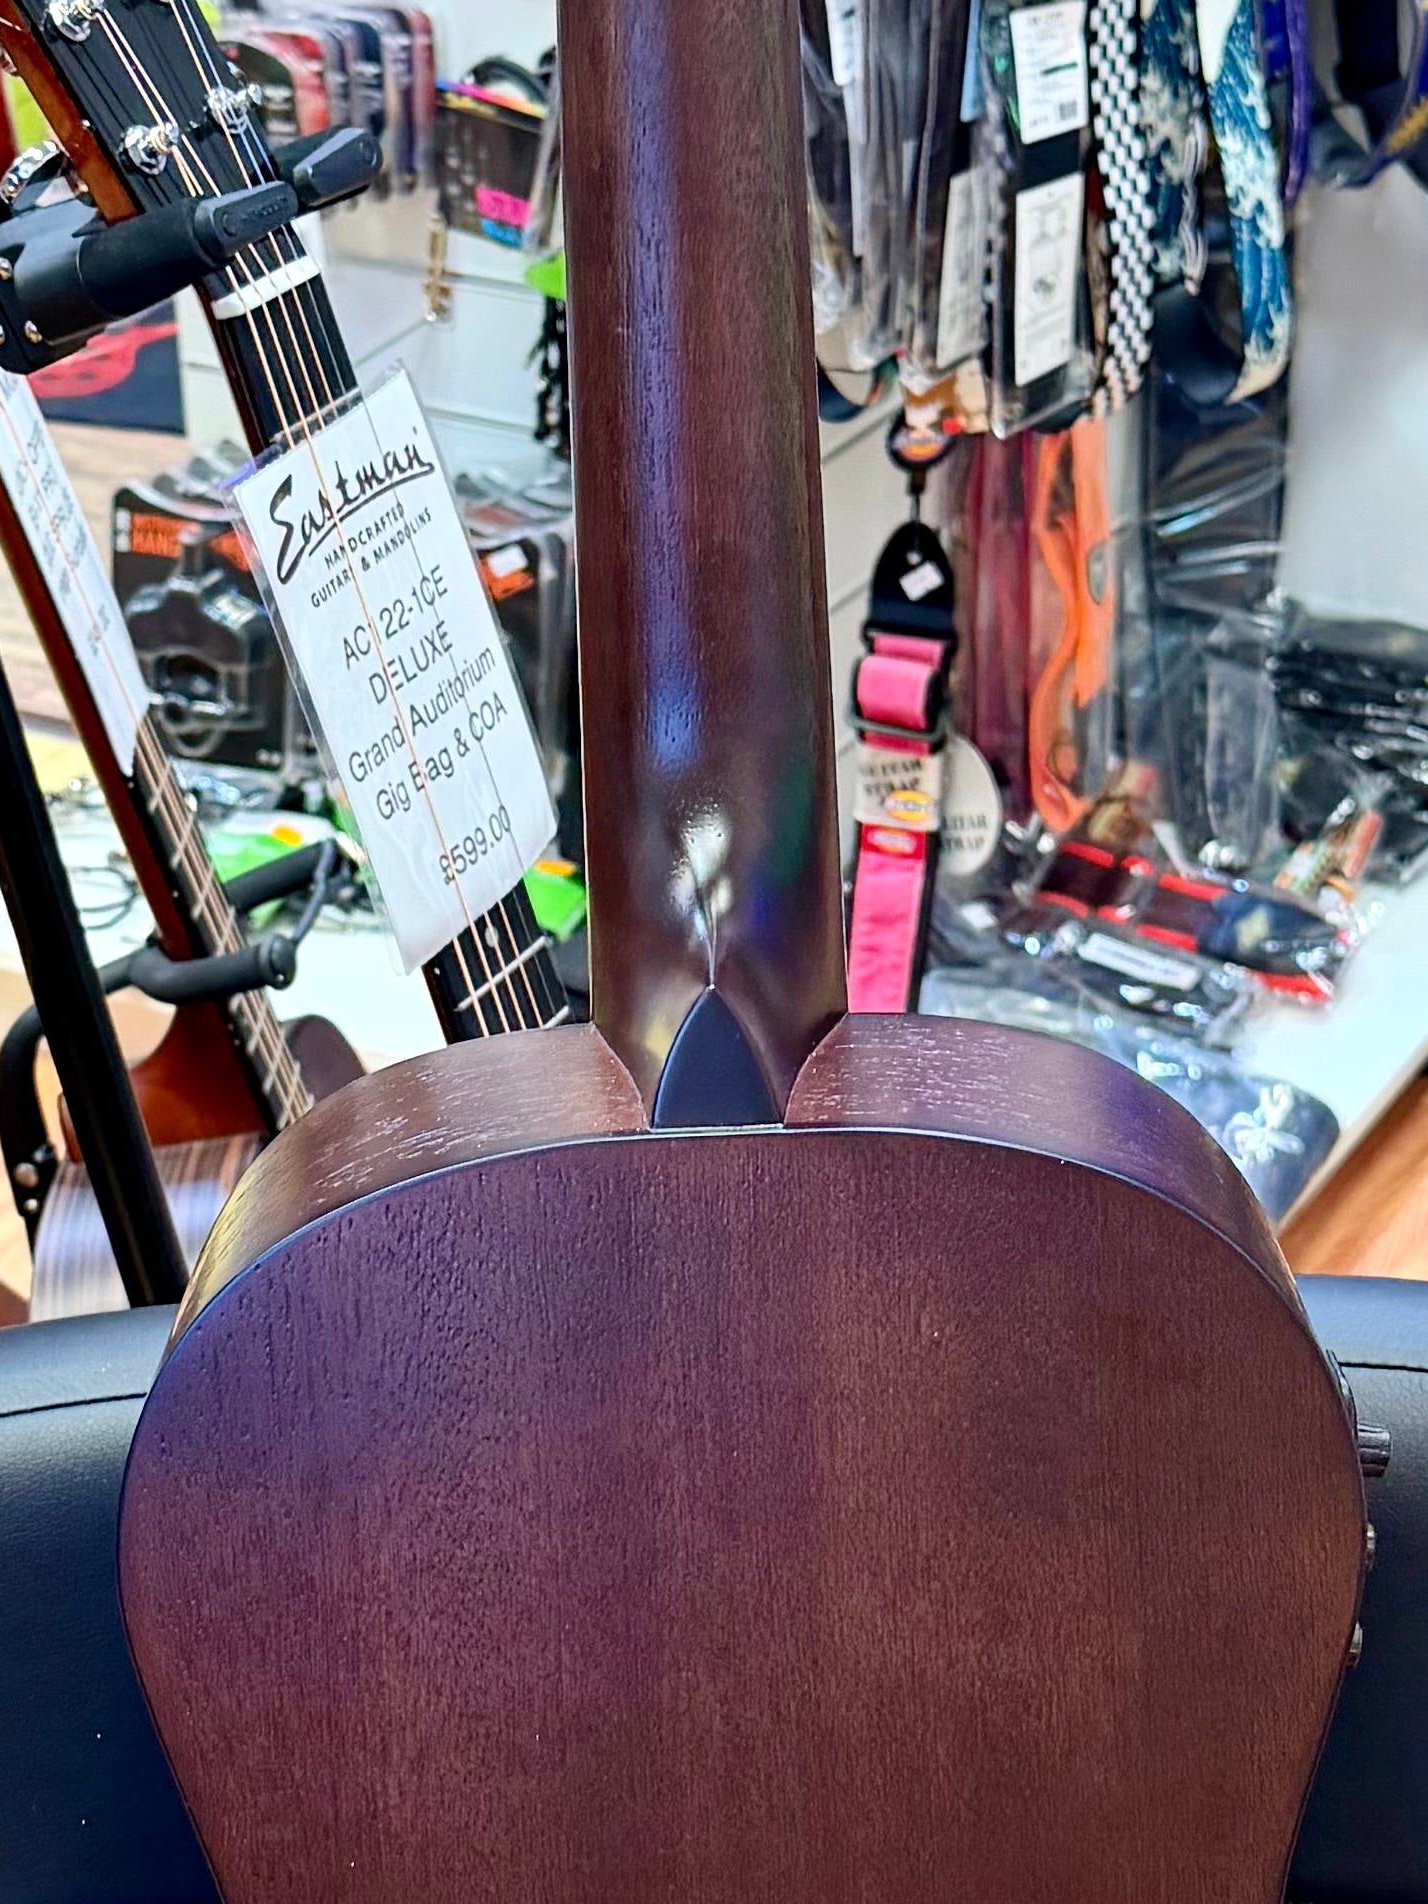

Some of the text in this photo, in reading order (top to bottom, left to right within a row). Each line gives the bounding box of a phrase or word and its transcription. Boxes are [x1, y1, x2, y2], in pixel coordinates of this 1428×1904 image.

[270, 443, 435, 585] Eastman
[310, 568, 355, 608] GUITAR
[372, 506, 433, 565] MANDOLINS
[325, 500, 405, 570] HANDCRAFTED
[369, 620, 453, 705] DELUXE
[348, 646, 497, 783] Grand Auditorium
[376, 690, 509, 821] Gig Bag & COA
[439, 804, 512, 886] £599.00
